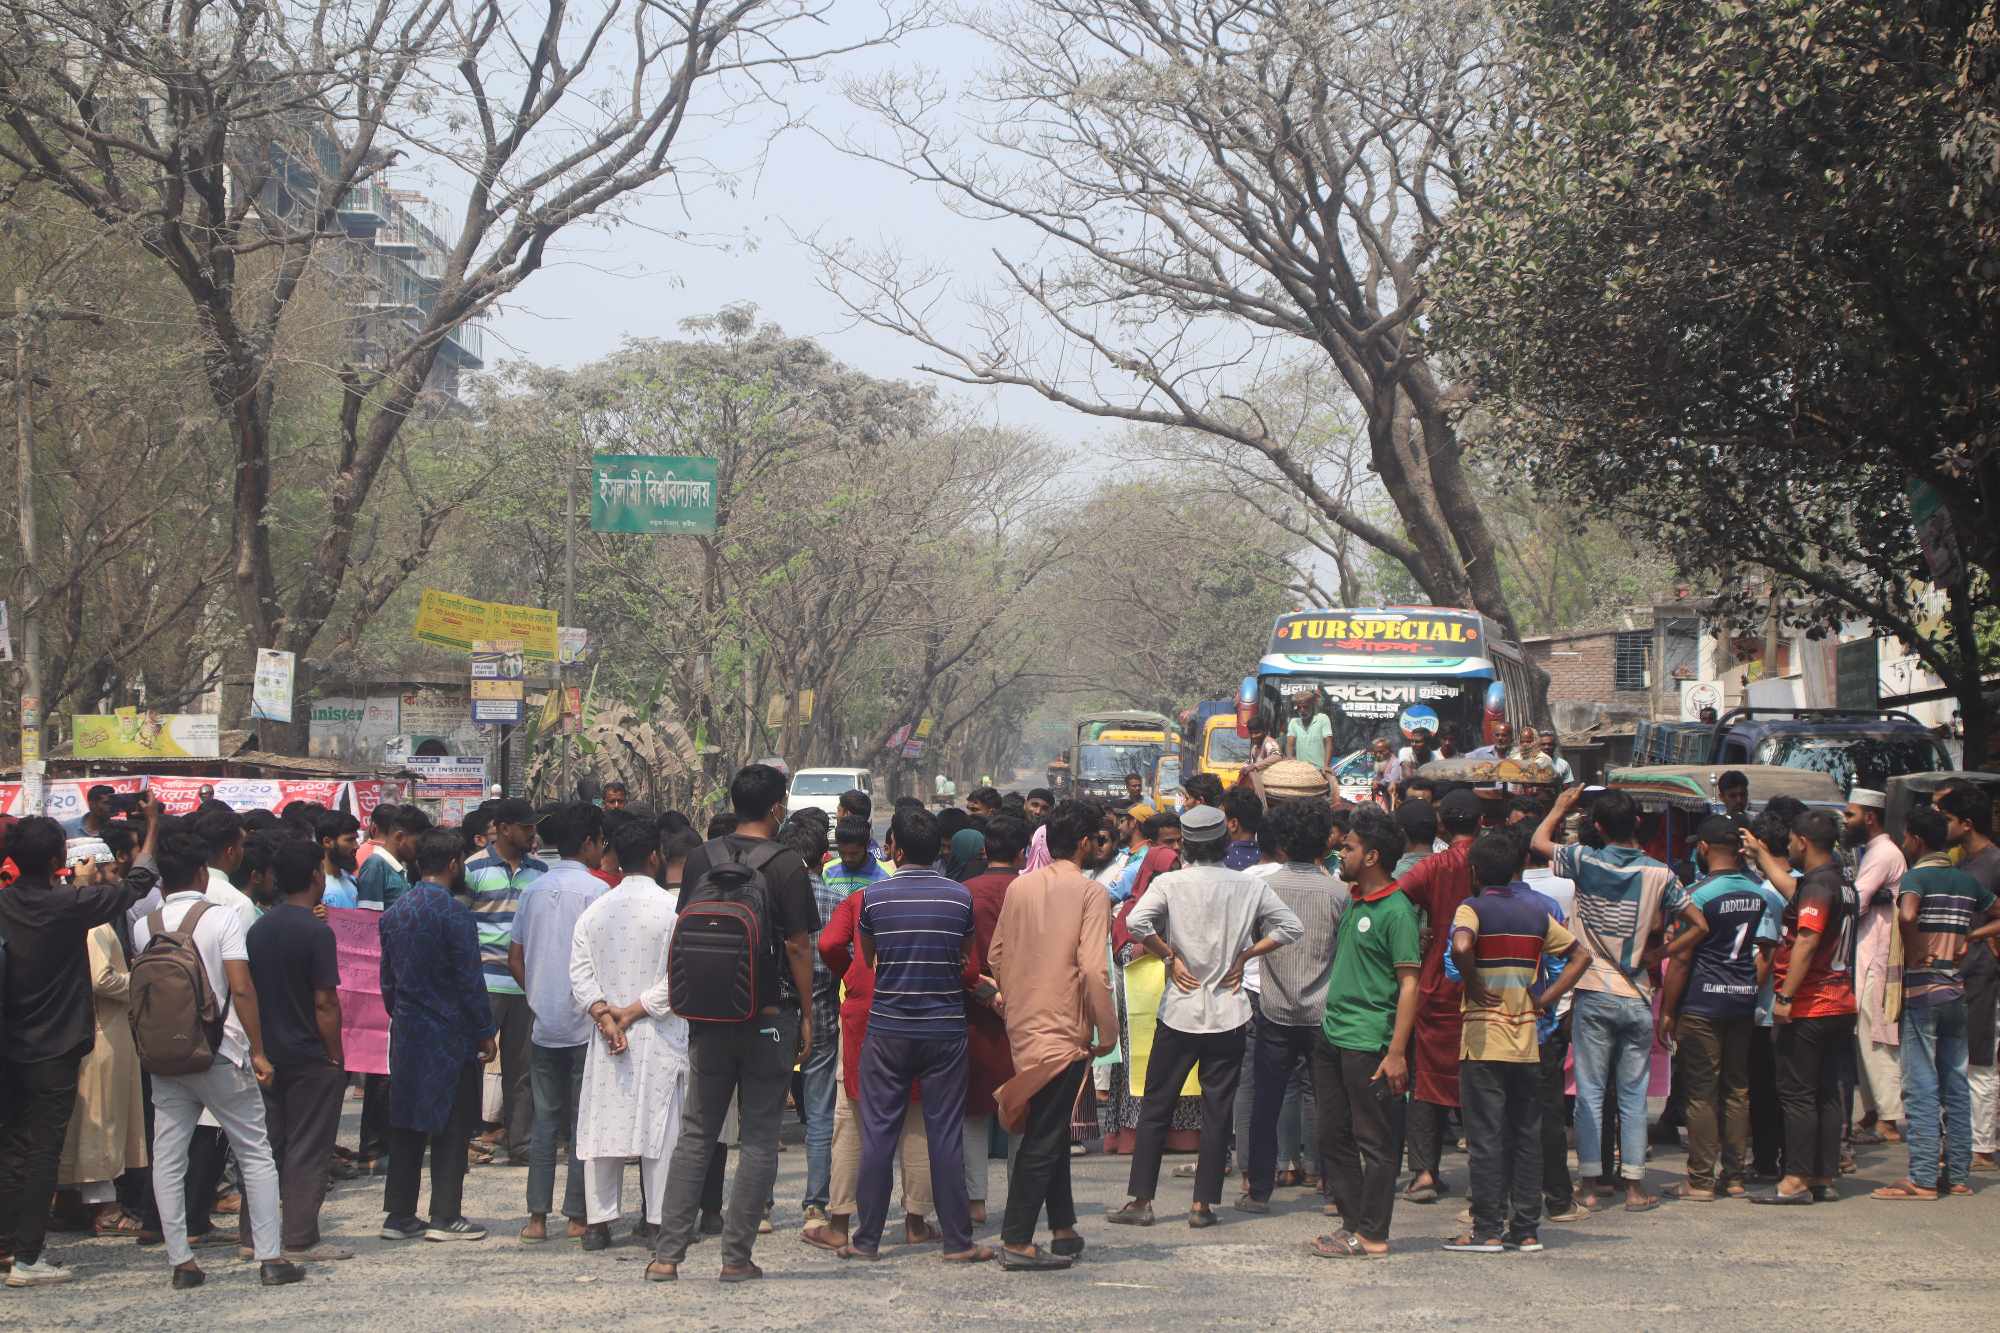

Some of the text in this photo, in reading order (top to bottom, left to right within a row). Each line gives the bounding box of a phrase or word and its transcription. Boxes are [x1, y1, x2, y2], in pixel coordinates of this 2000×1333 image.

[1288, 619, 1466, 643] TUR SPECIAL
[1720, 898, 1761, 914] ABDULLAH
[1730, 921, 1749, 960] 1
